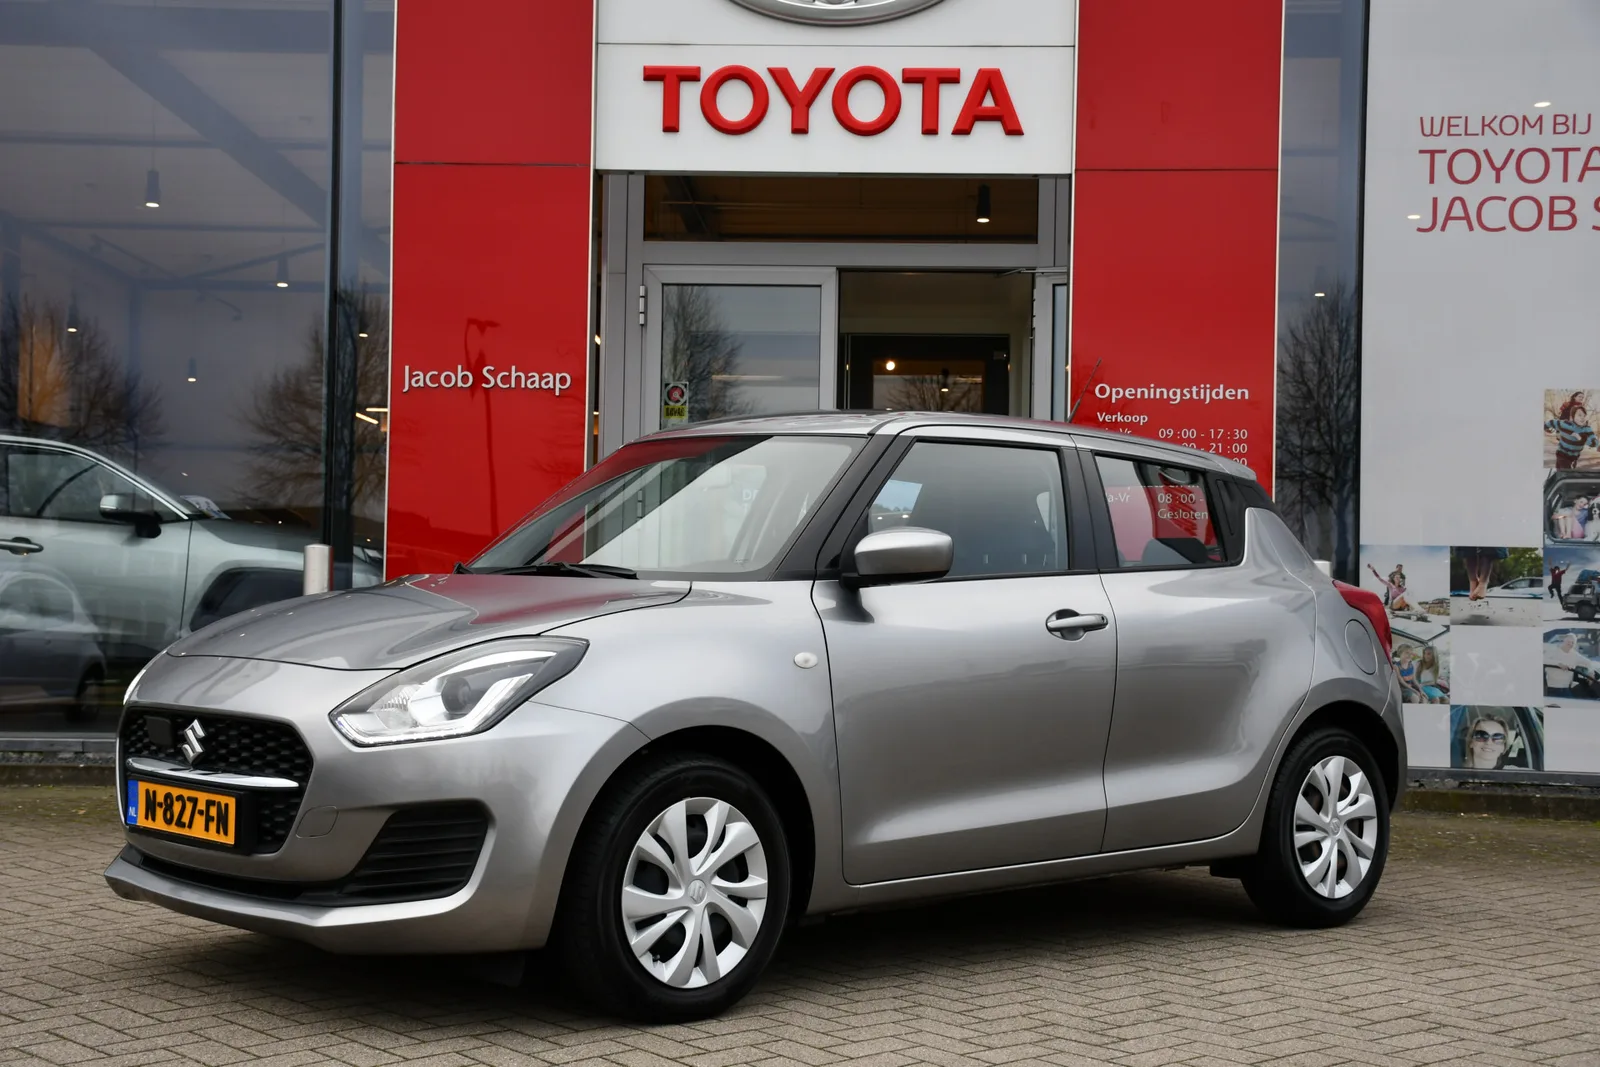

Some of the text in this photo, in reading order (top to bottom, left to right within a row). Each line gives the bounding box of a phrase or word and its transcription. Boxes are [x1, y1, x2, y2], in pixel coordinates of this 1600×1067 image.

[643, 65, 1024, 136] TOYOTA
[1420, 113, 1592, 137] WELKOM BIJ
[1418, 146, 1600, 185] TOYOTA
[1416, 195, 1578, 233] JACOB
[402, 365, 572, 396] Jacob Schaap
[1094, 383, 1250, 404] Openingstijden
[1097, 412, 1149, 426] Verkoop
[1107, 493, 1131, 503] a-Vr
[1157, 508, 1209, 520] Gesloten
[144, 788, 229, 836] N-827-FN
